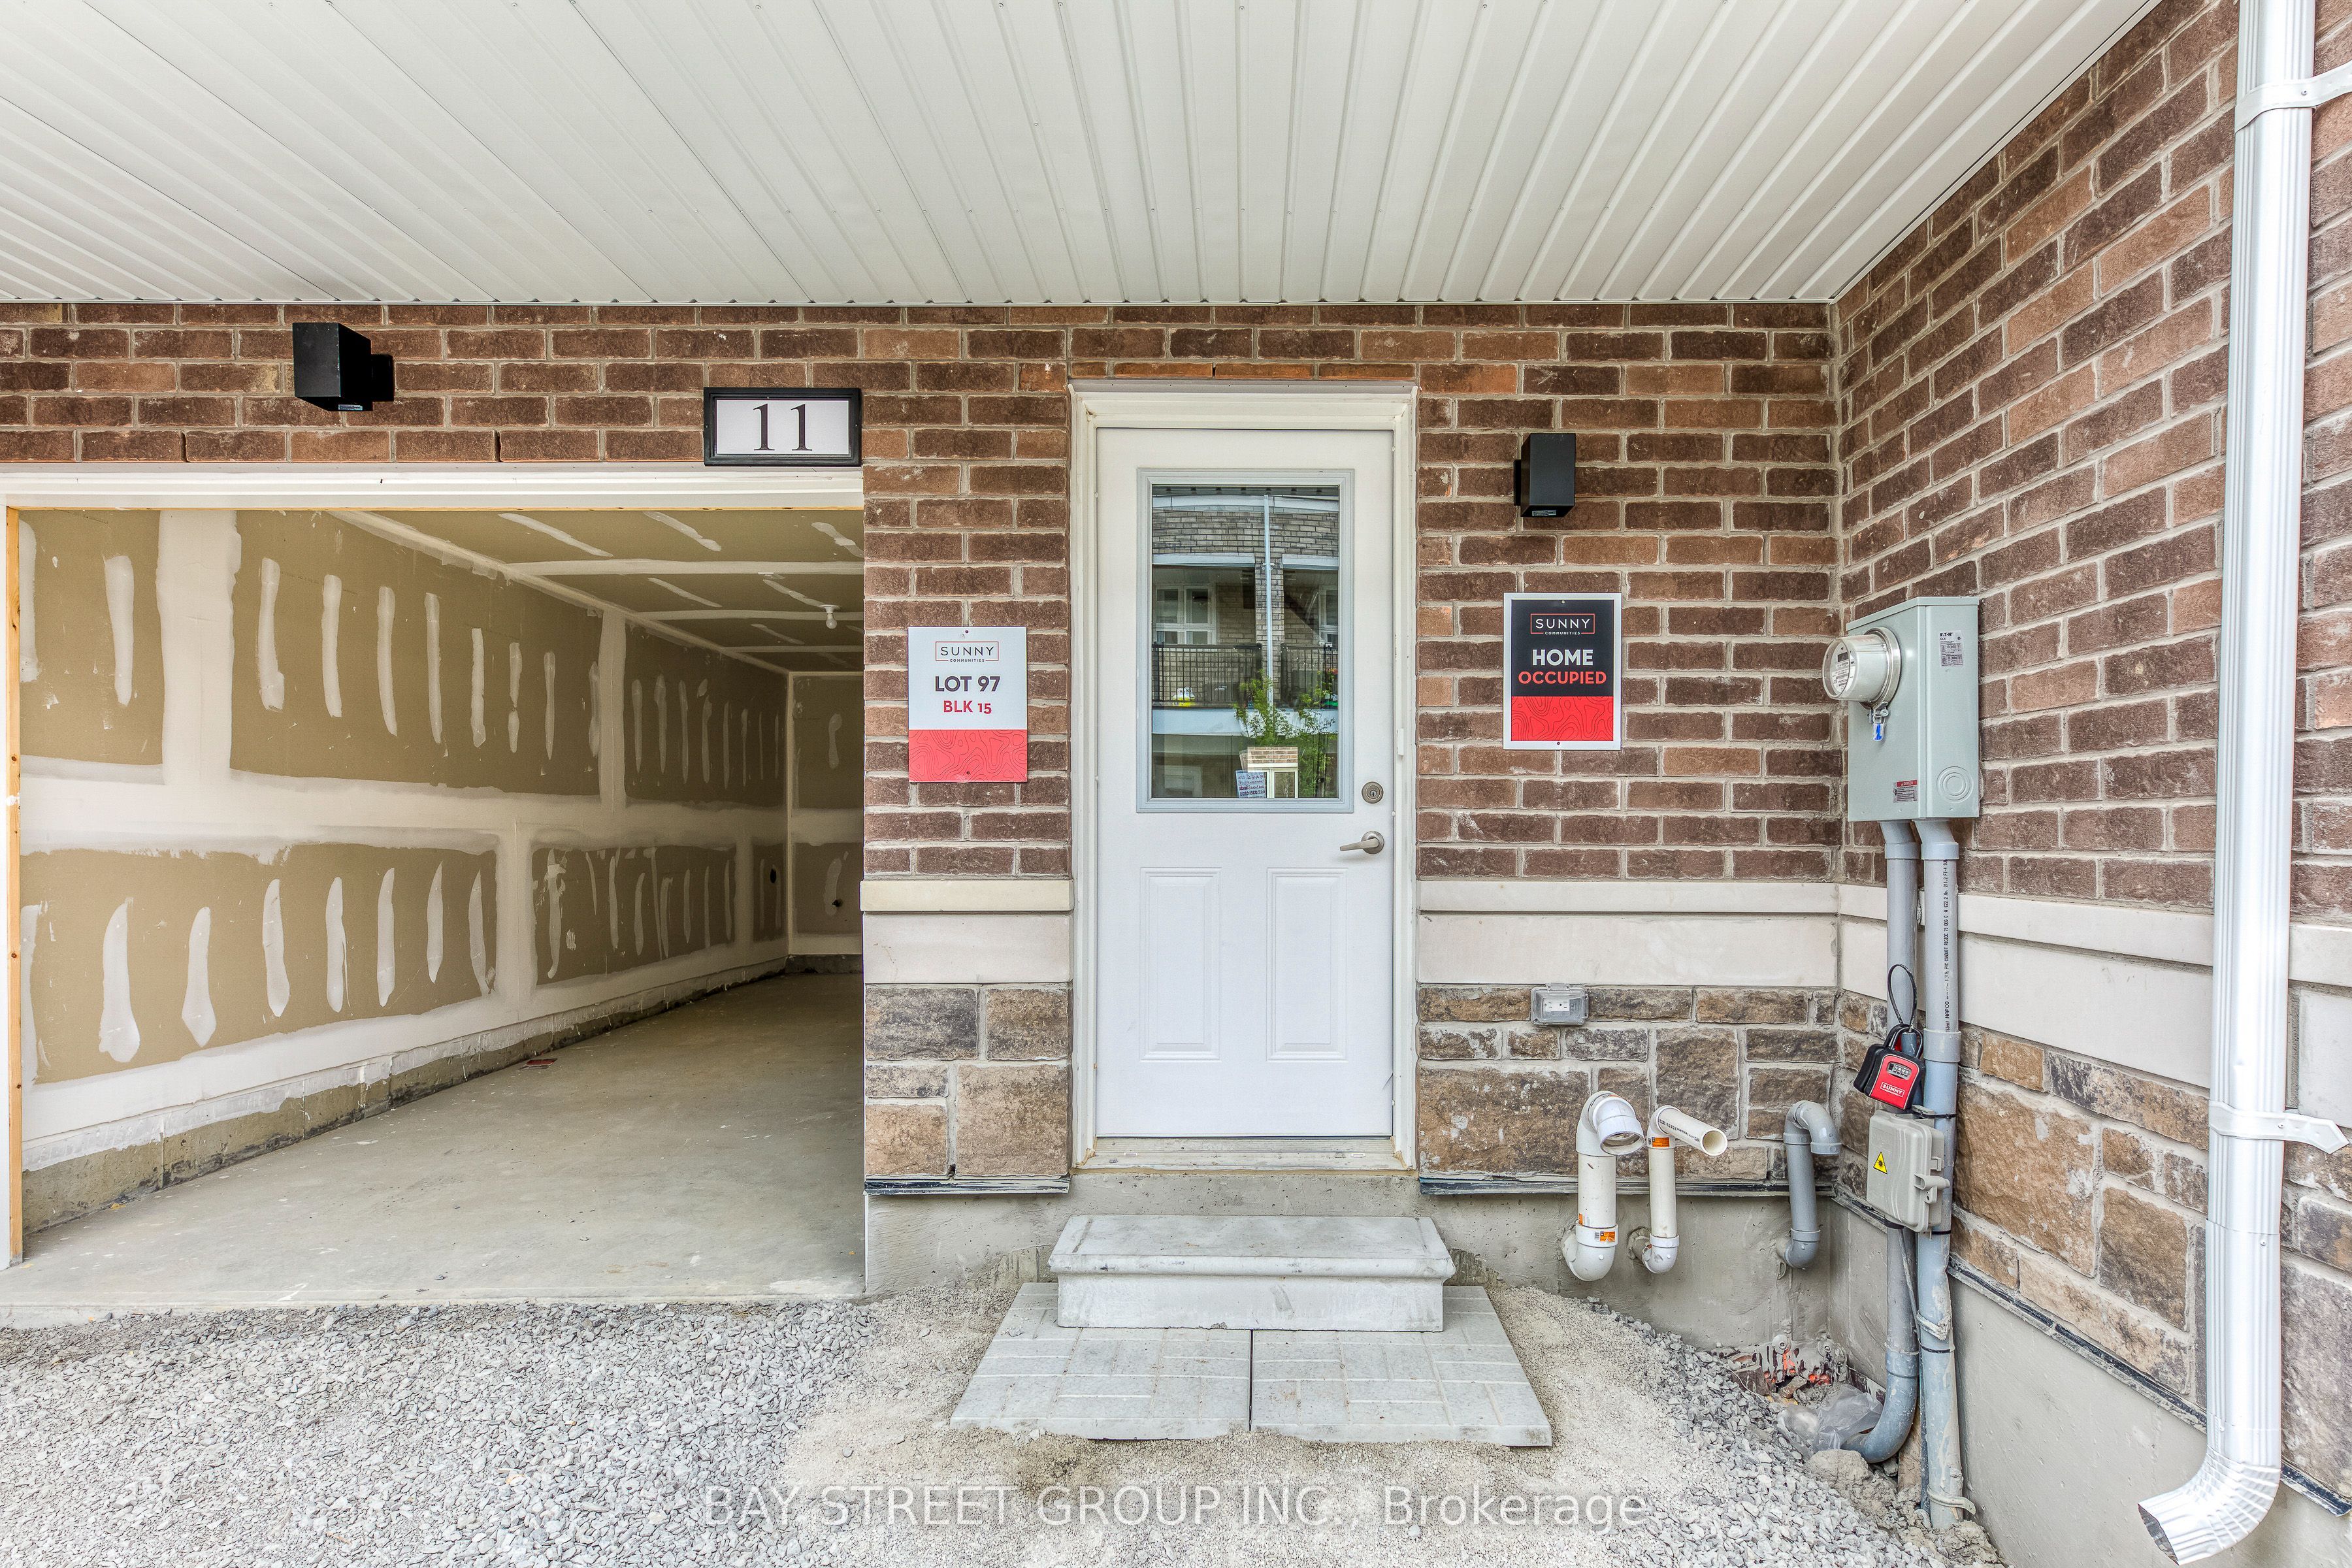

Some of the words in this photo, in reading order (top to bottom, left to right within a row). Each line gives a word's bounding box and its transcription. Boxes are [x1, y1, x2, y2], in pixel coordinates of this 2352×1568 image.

[753, 403, 813, 451] 11
[1535, 618, 1590, 629] SUNNY
[941, 646, 994, 656] SUNNY
[1532, 649, 1593, 666] HOME
[935, 676, 972, 692] LOT
[977, 676, 1000, 692] 97
[1518, 671, 1607, 685] OCCUPIED
[943, 700, 973, 713] BLK
[977, 703, 992, 715] 15
[1882, 1083, 1903, 1094] SUNNY
